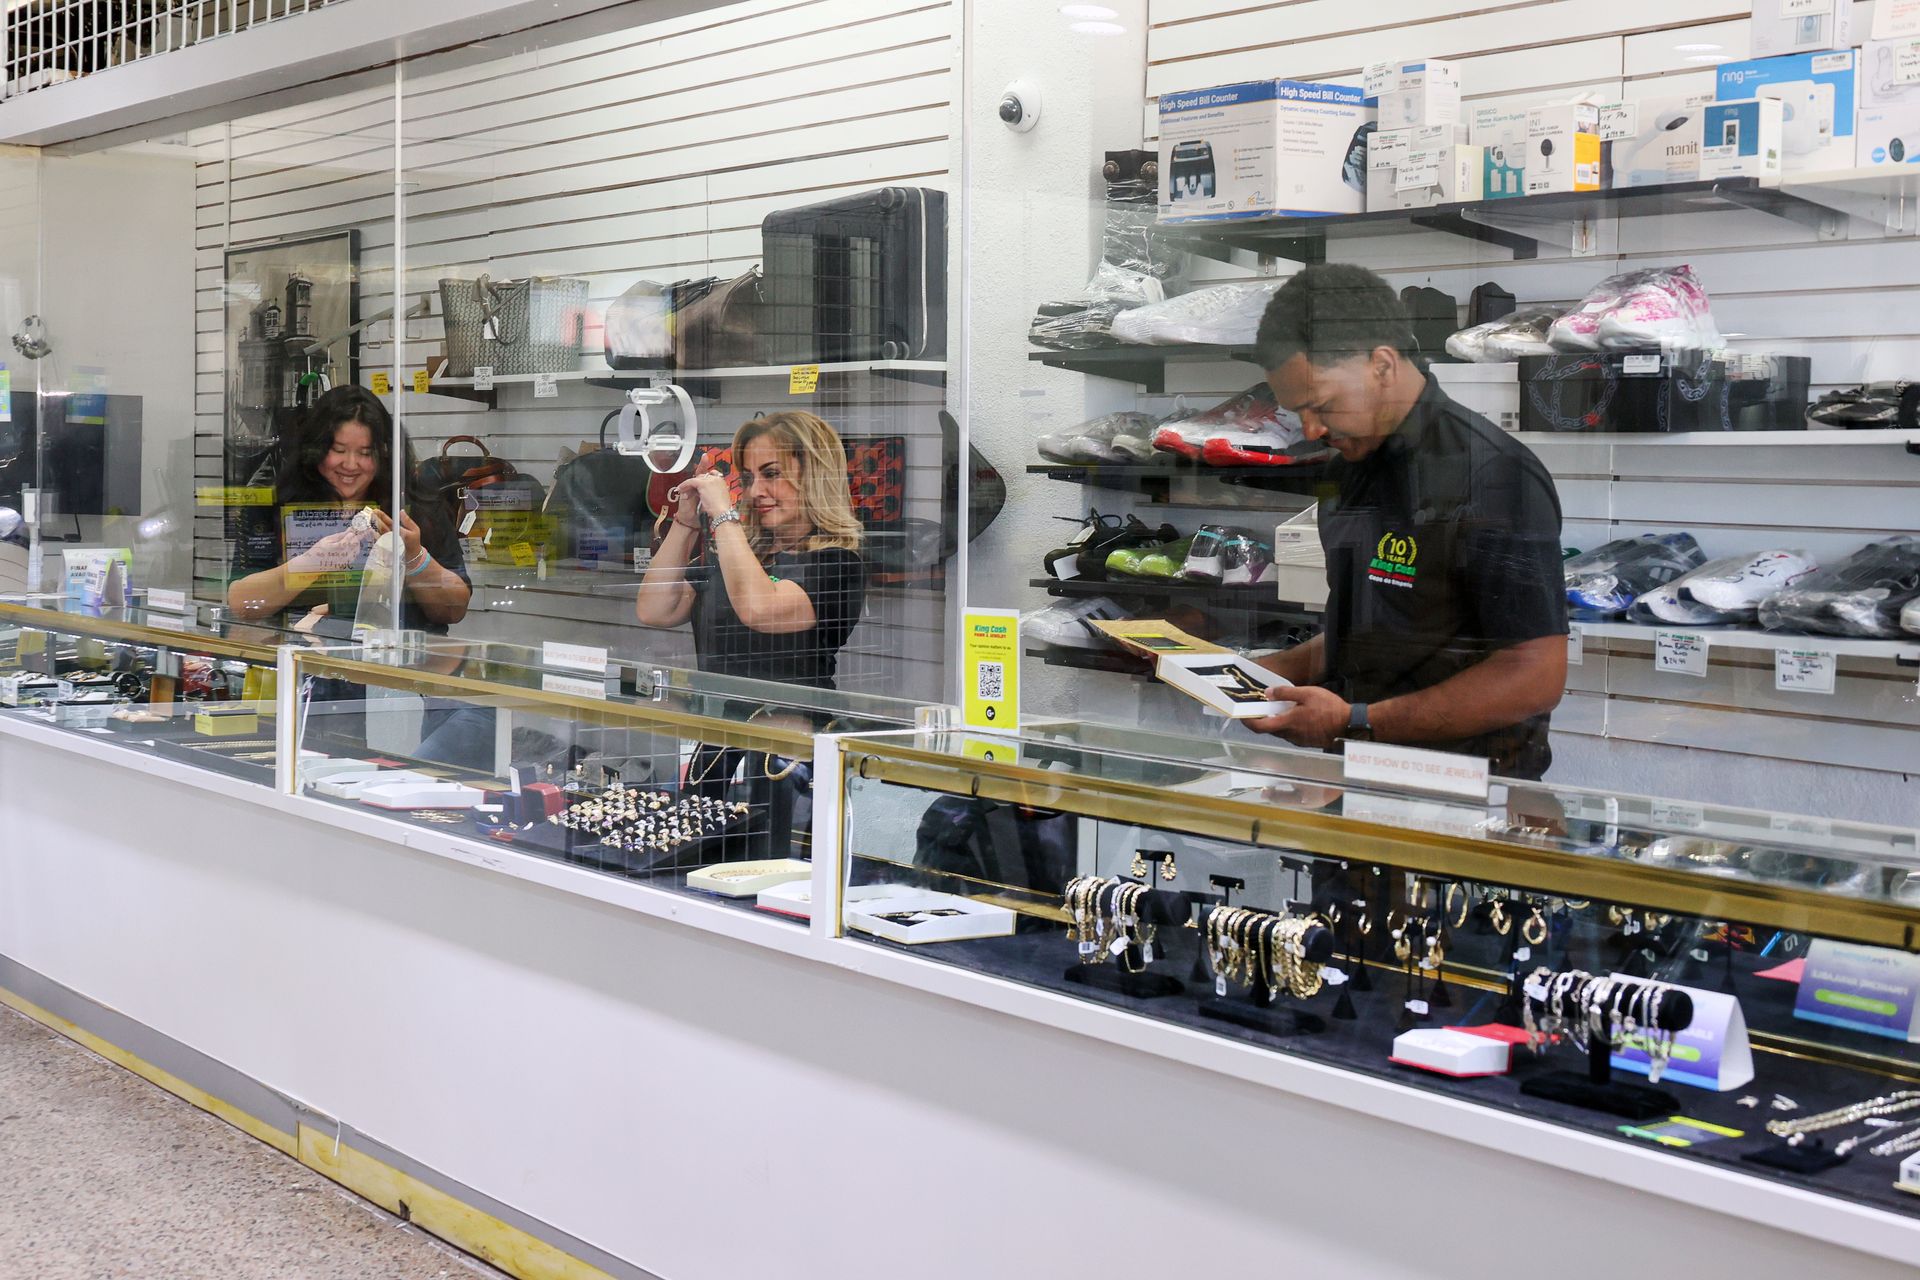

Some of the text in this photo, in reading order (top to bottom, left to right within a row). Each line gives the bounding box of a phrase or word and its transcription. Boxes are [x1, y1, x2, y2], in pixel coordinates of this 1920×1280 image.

[1722, 70, 1744, 84] ring
[1281, 86, 1361, 102] High Speed Bill Counter
[1160, 93, 1239, 112] High Speed Bill Counter
[1666, 141, 1698, 156] nanit
[1390, 538, 1407, 556] 10
[1370, 558, 1416, 576] King Cash
[1386, 554, 1406, 564] YEARS
[975, 624, 990, 634] King
[1348, 754, 1484, 780] MUST SHOW ID TO SEE JEWELRY
